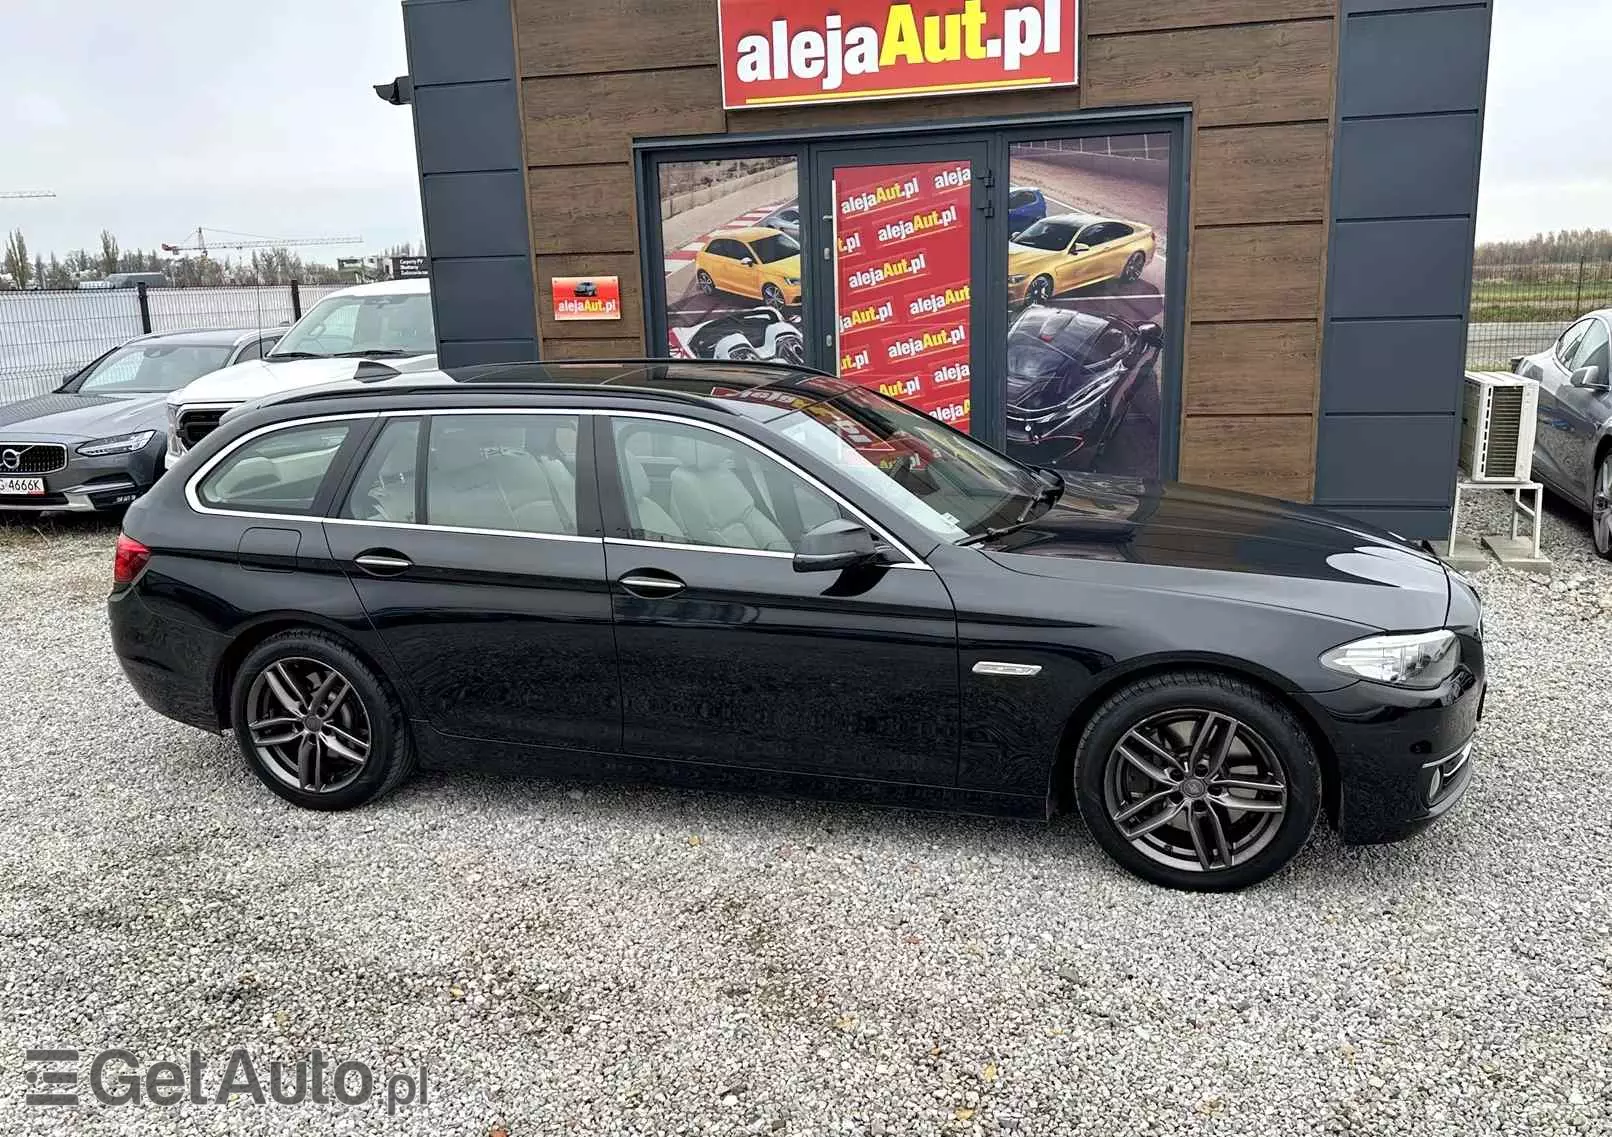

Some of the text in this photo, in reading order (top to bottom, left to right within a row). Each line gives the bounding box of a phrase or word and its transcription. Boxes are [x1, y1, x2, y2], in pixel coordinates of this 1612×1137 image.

[736, 0, 1061, 90] alejaAut.pl
[841, 177, 920, 215] alejaAut.pl
[877, 205, 957, 242] alejaAut.pl
[848, 253, 927, 289] alejaAut.pl
[558, 298, 616, 314] alejaAut.pl
[887, 325, 965, 358] alejaAut.pl
[933, 363, 970, 383] aleja
[9, 479, 41, 491] 4666K
